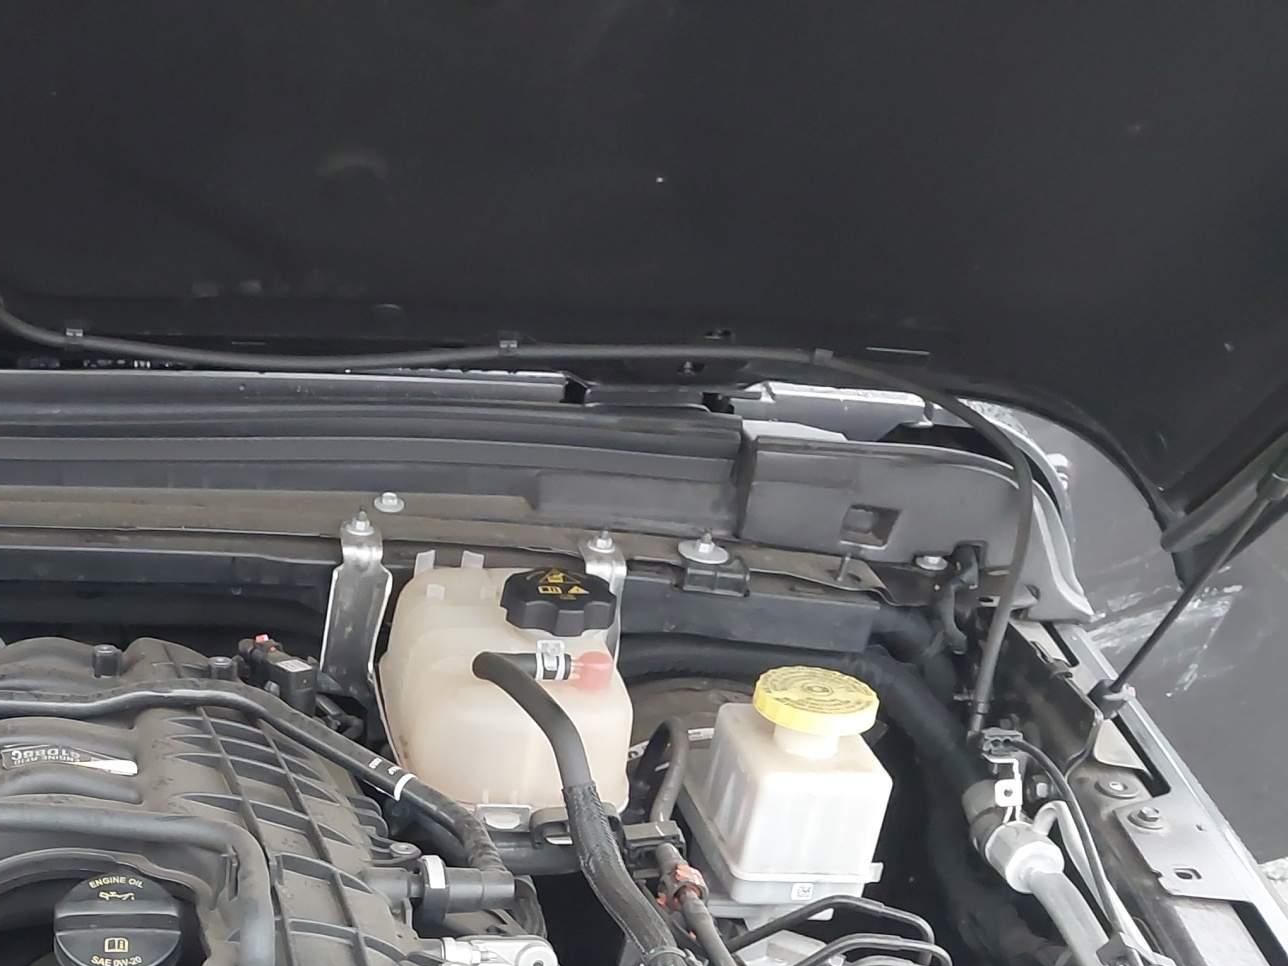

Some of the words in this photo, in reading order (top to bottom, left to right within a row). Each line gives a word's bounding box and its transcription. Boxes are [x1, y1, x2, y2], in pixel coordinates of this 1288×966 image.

[88, 876, 126, 889] ENGINE
[128, 877, 145, 889] OIL
[90, 955, 112, 966] SAE
[113, 956, 142, 966] 0W-20
